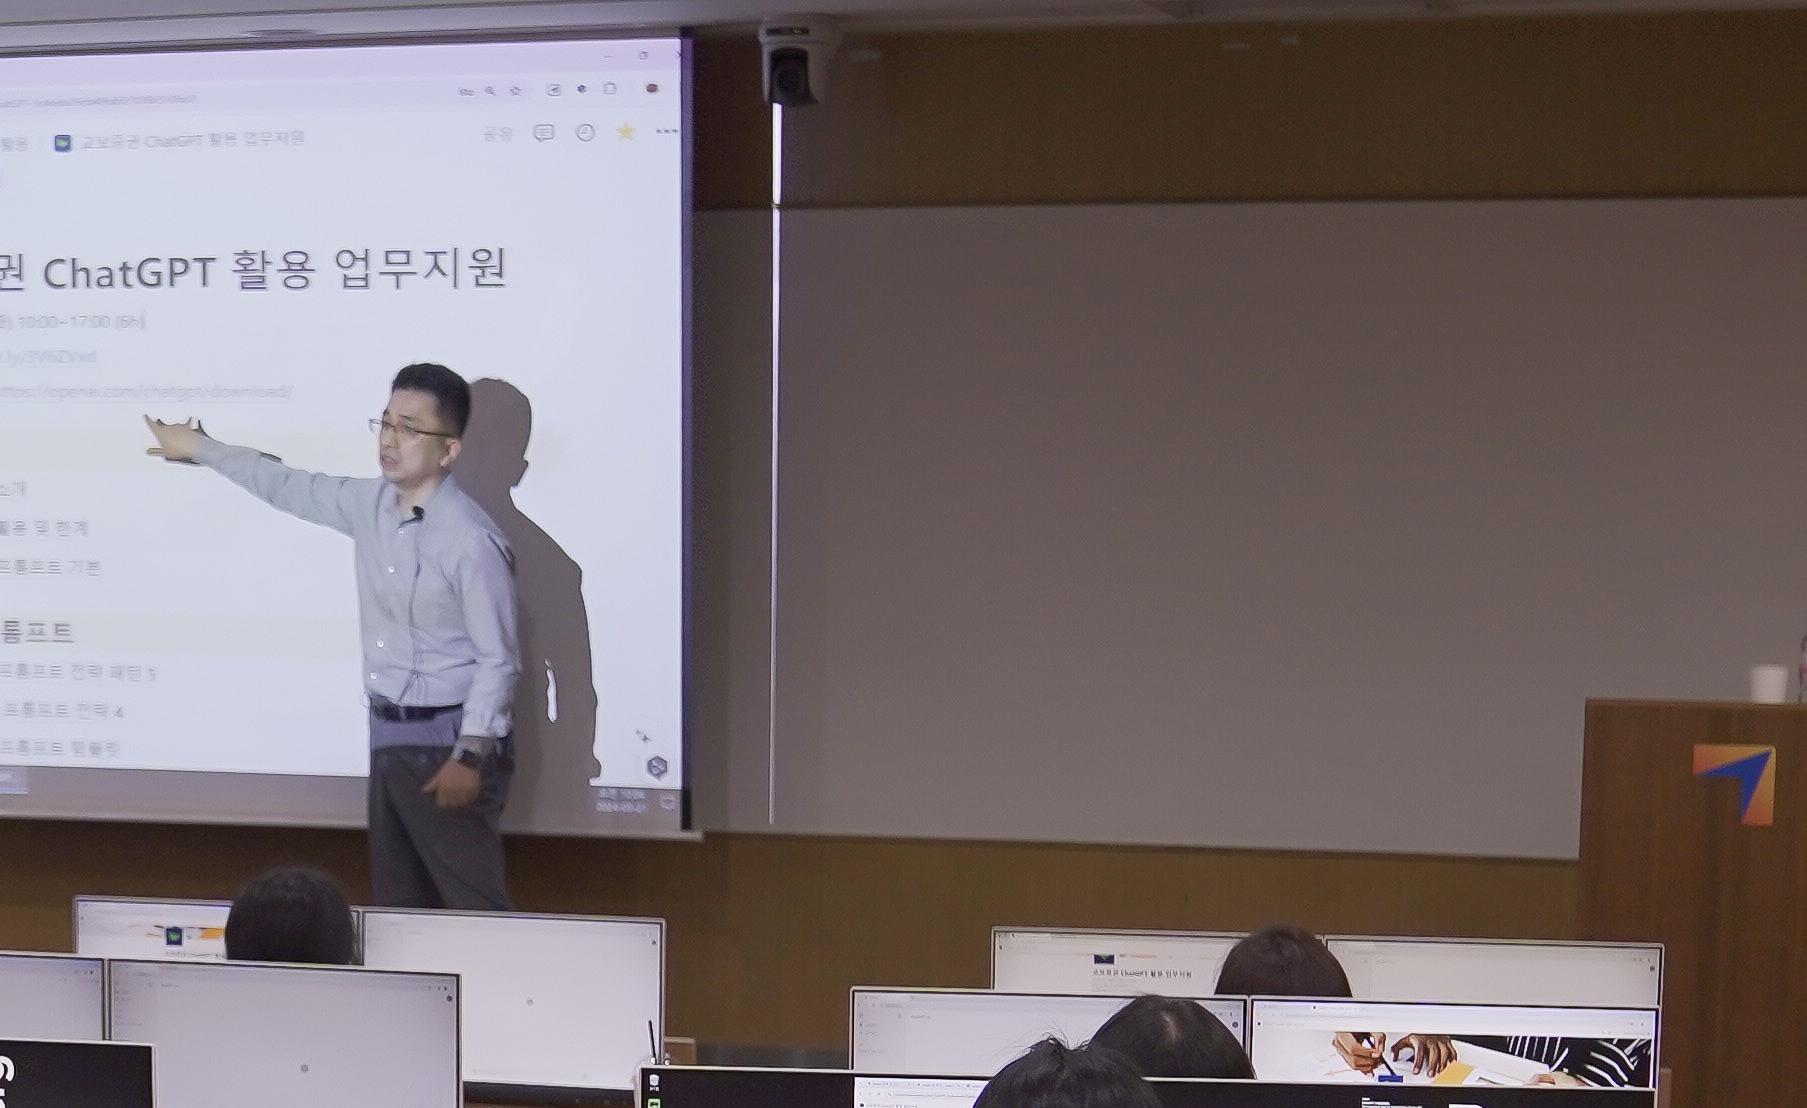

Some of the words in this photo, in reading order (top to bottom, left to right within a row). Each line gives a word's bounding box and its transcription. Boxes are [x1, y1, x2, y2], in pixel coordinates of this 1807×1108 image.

[44, 256, 217, 289] ChatGPT
[232, 249, 316, 290] 활용
[336, 247, 506, 289] 업무지원
[56, 520, 88, 537] 한계
[70, 560, 100, 576] 기본
[71, 664, 102, 680] 전략
[5, 702, 70, 718] 프롬프트
[0, 740, 63, 755] 프롬프트
